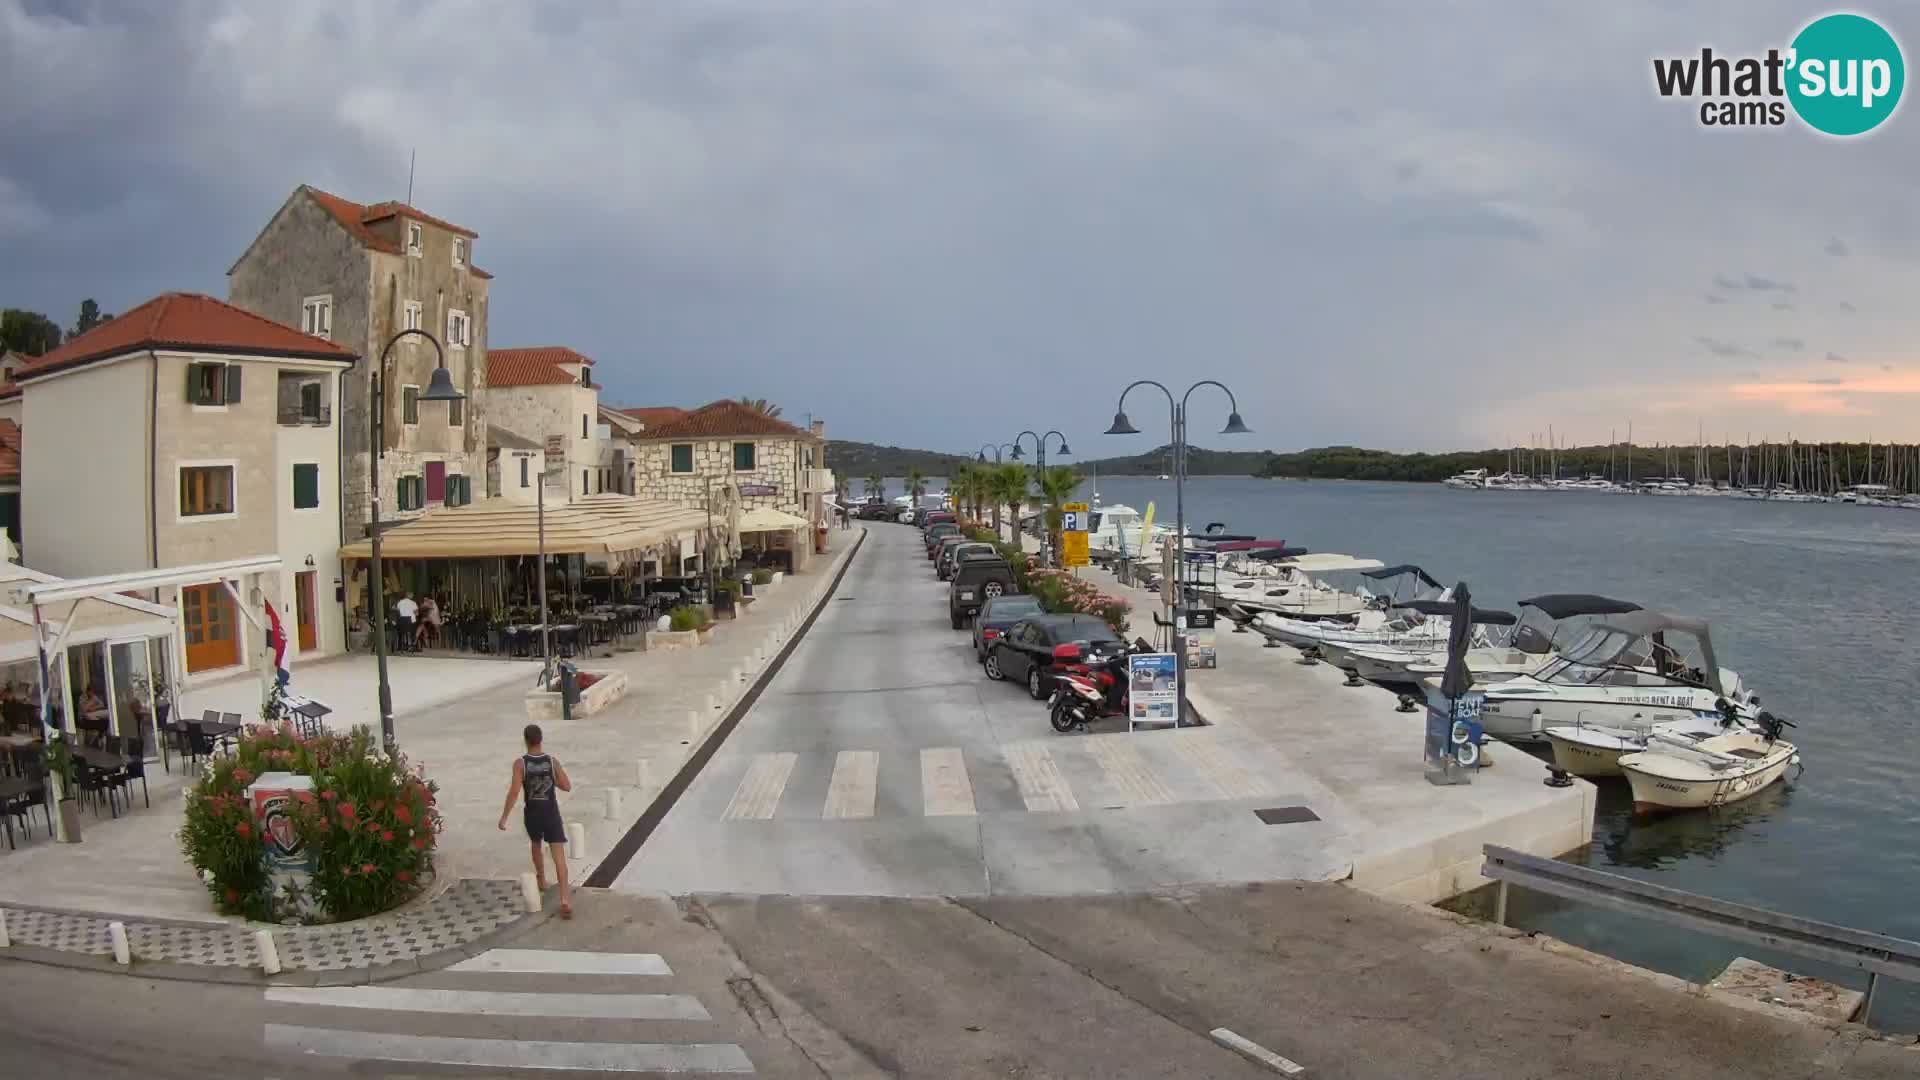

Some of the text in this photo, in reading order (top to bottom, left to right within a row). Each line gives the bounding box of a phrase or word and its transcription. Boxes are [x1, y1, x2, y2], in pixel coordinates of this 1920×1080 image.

[1065, 513, 1076, 529] P
[1651, 695, 1670, 705] RENT
[1676, 696, 1694, 708] BOAT
[1457, 708, 1481, 718] BOAT
